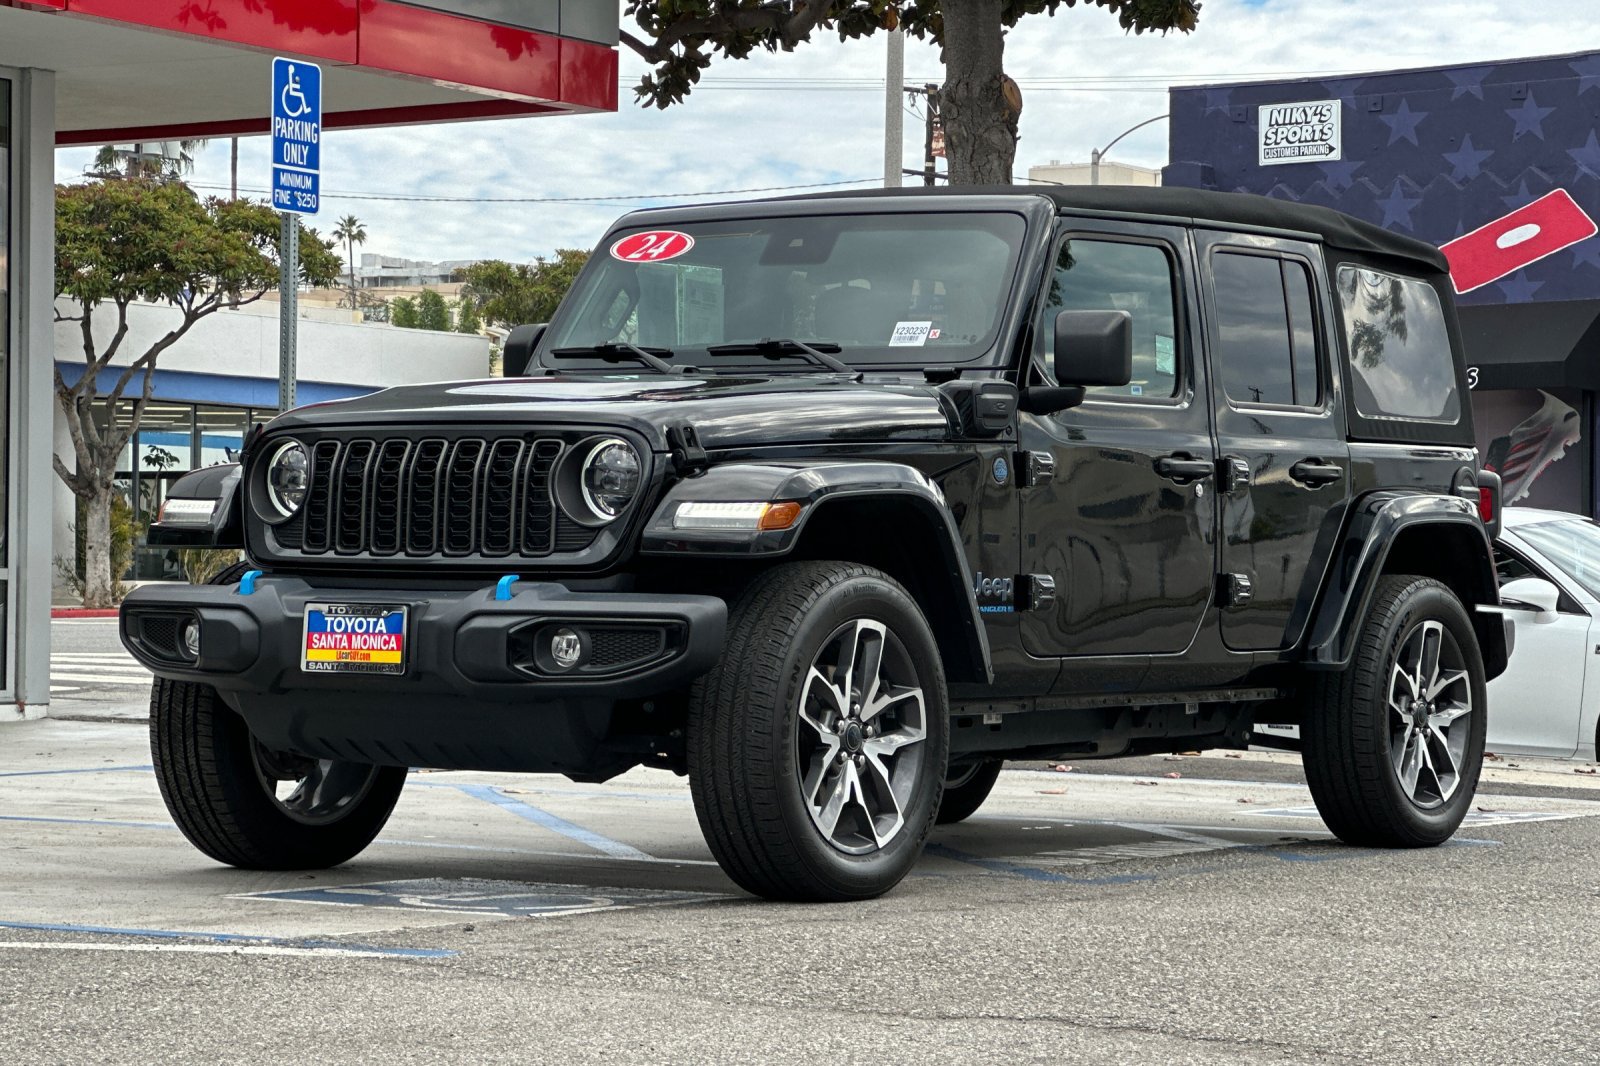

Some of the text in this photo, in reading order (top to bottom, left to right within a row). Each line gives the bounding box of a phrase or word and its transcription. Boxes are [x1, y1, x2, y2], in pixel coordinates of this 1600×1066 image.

[1269, 104, 1333, 127] NIKY'S
[275, 116, 318, 144] PARKING
[1264, 123, 1335, 146] SPORTS
[283, 141, 309, 166] ONLY
[1264, 144, 1330, 158] CUSTOMER PARKING
[280, 171, 312, 190] MINIMUM
[274, 188, 317, 209] FINE $250
[624, 233, 679, 259] 24
[973, 571, 1014, 602] Jeep
[324, 616, 387, 634] TOYOTA
[312, 633, 397, 650] SANTA MONICA
[308, 662, 345, 670] SANTA
